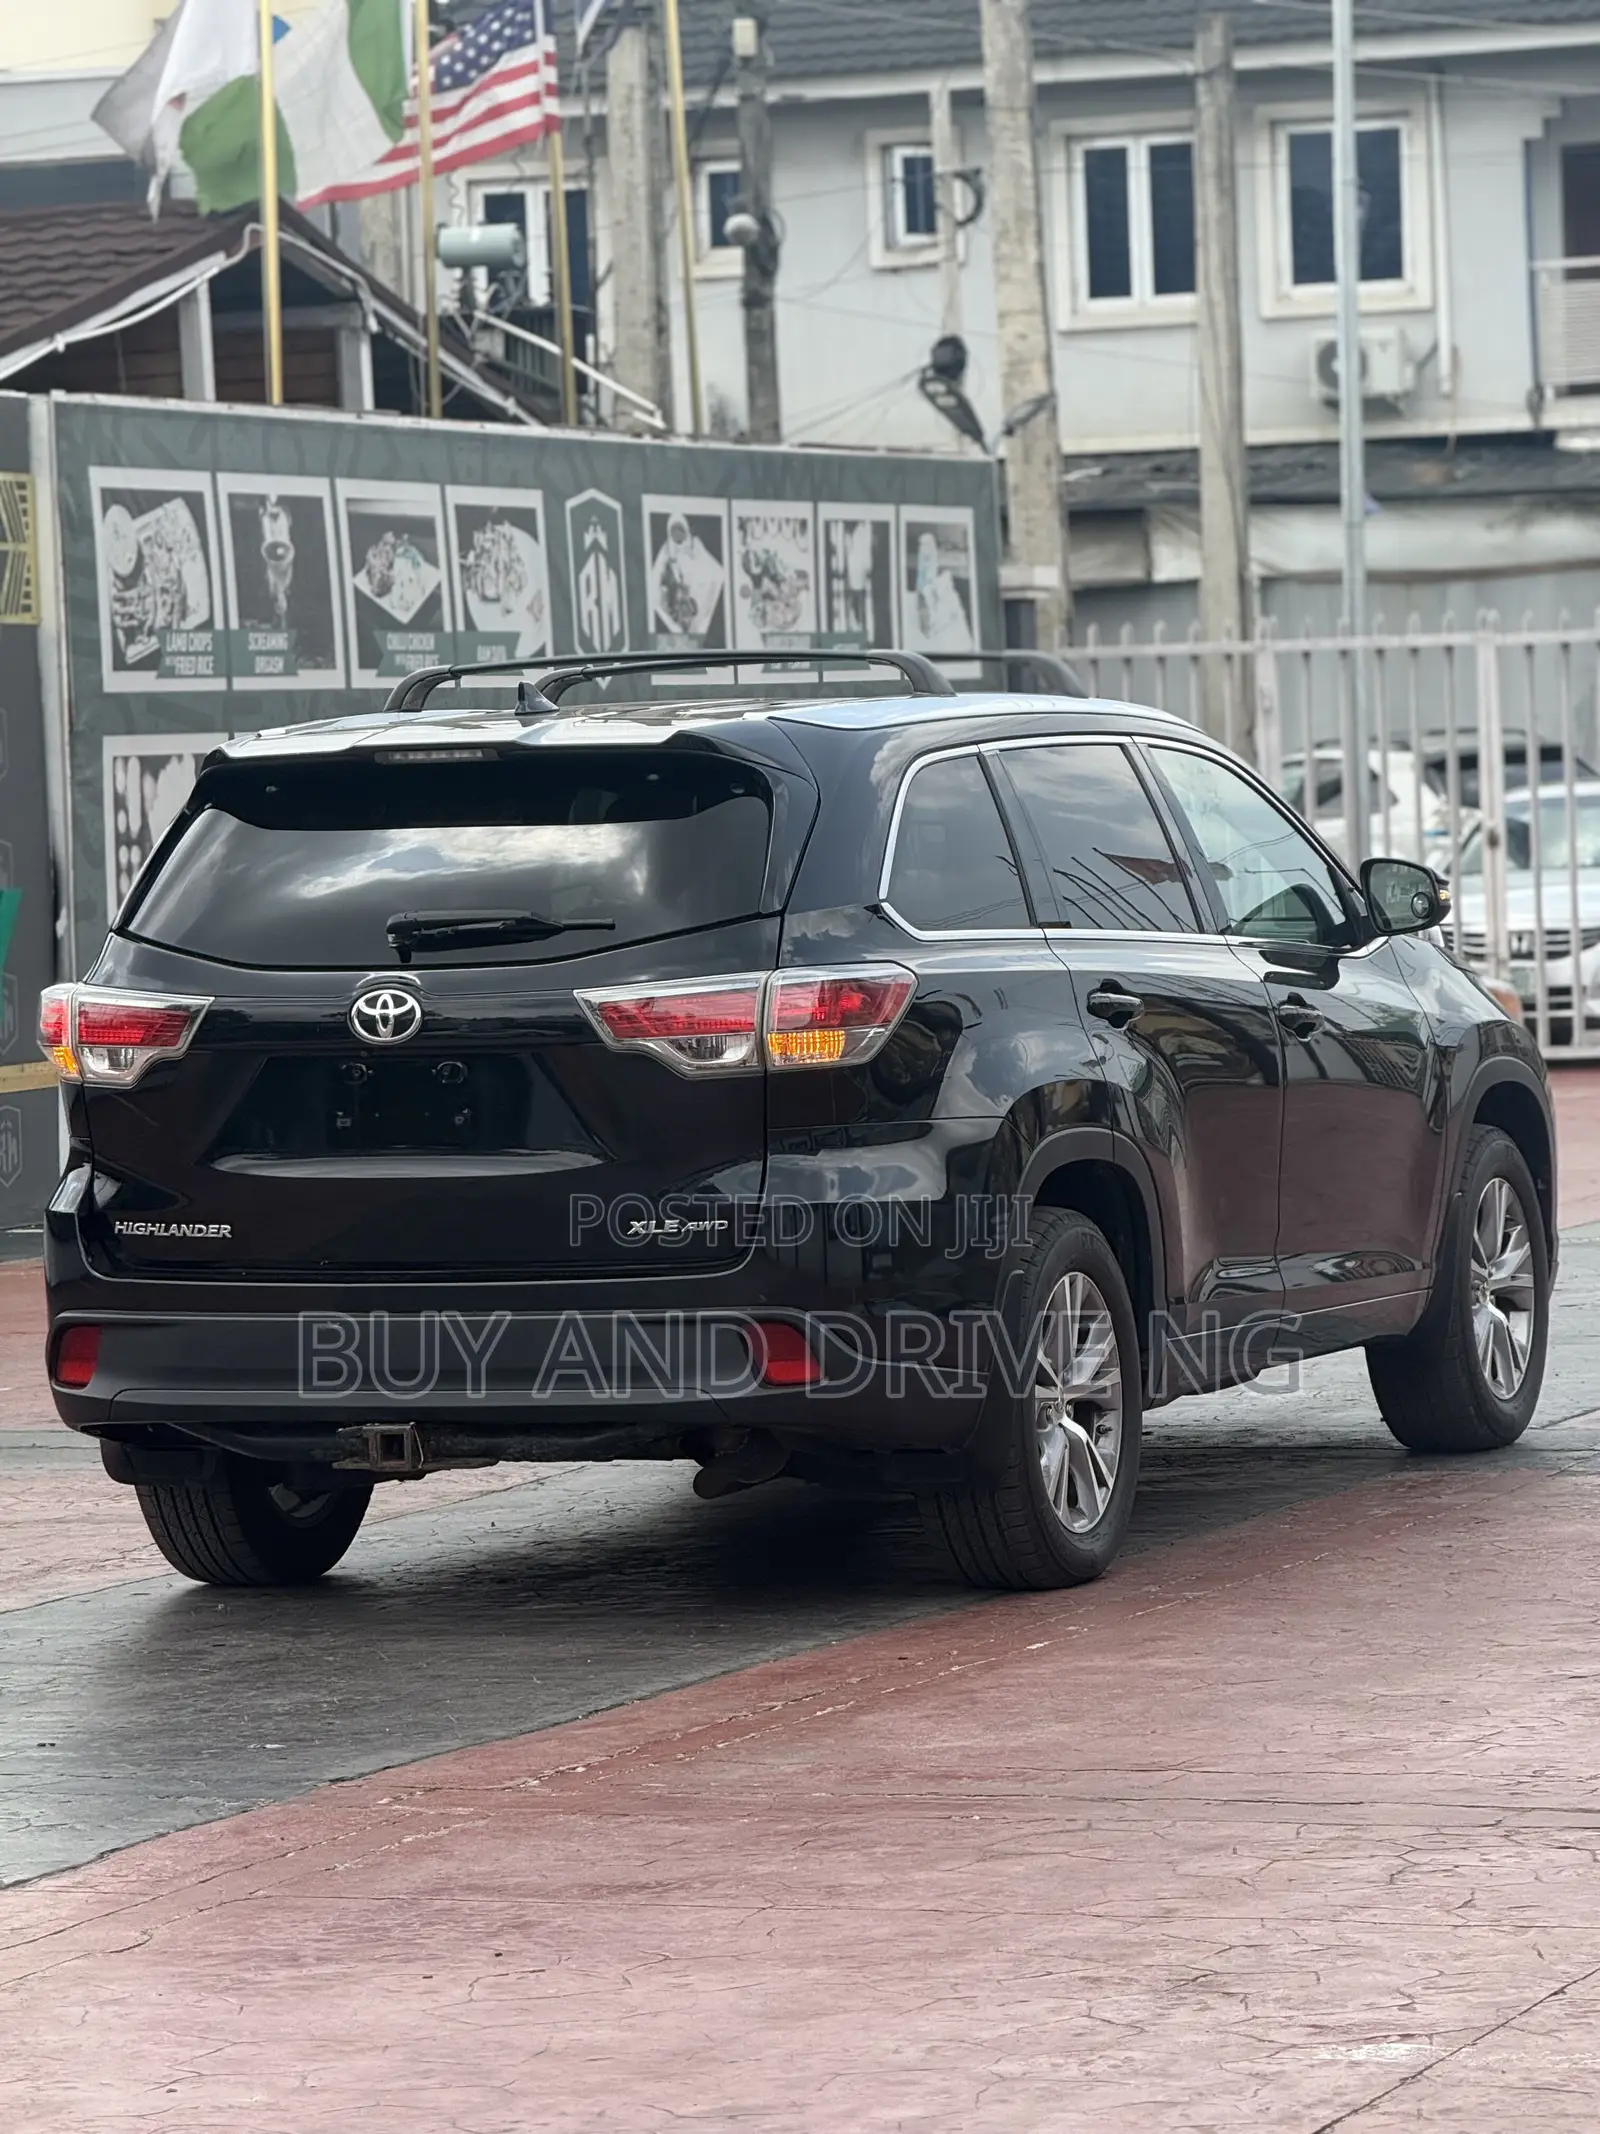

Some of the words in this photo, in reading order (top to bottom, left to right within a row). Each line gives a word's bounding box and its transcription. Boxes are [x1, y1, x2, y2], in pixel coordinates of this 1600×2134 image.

[114, 1221, 232, 1238] HIGHLANDER
[627, 1220, 680, 1235] XLE
[681, 1220, 728, 1233] AWD
